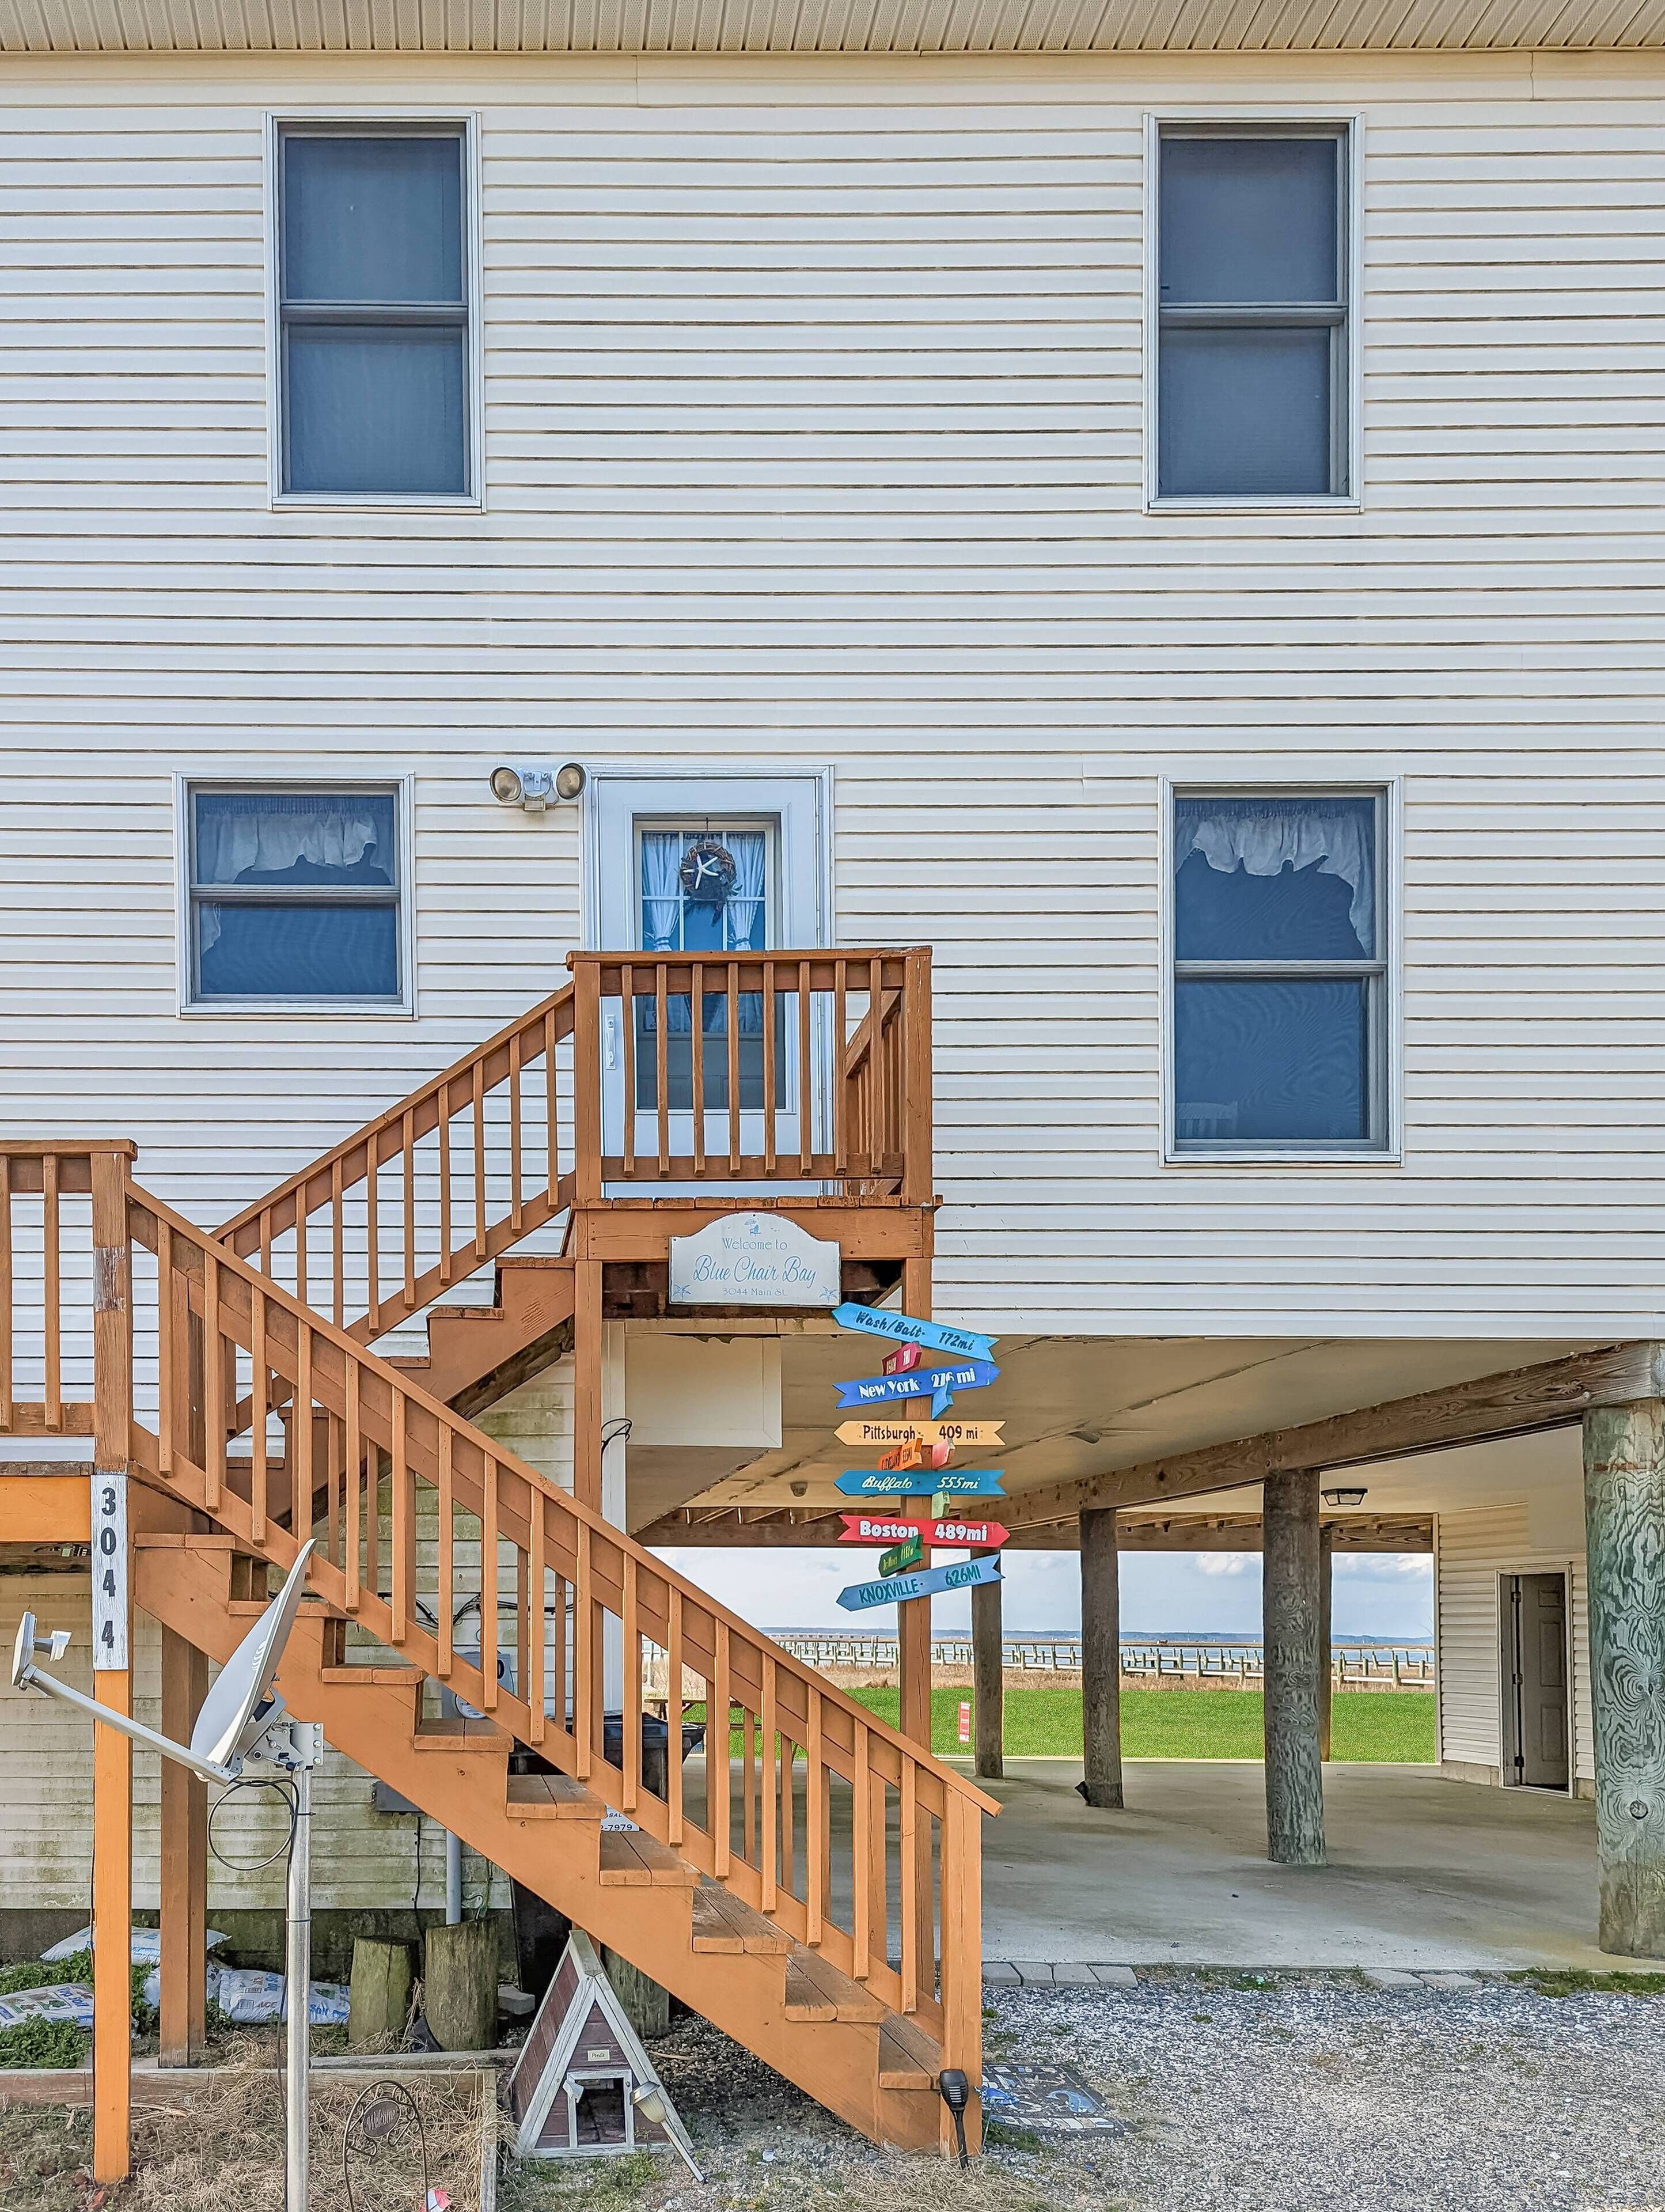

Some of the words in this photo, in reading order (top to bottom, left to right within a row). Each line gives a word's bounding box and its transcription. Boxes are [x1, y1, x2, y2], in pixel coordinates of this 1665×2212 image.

[722, 1237, 772, 1250] Welcome
[775, 1239, 787, 1251] to
[693, 1254, 731, 1282] Blue
[734, 1256, 779, 1282] Chair
[782, 1256, 817, 1289] Bay
[723, 1287, 748, 1296] 3044
[751, 1287, 771, 1296] Main
[859, 1384, 885, 1398] New
[889, 1378, 920, 1395] York
[957, 1368, 976, 1384] mi
[863, 1425, 916, 1444] Pittsburgh
[939, 1425, 962, 1440] 409
[966, 1426, 978, 1439] mi
[862, 1476, 913, 1491] Buffalo
[936, 1476, 981, 1489] 555mi
[860, 1520, 919, 1539] Boston
[935, 1524, 988, 1541] 489mi
[100, 1487, 116, 1649] 3044
[858, 1578, 920, 1604] KNOXVILLE
[945, 1565, 982, 1587] 626MI
[366, 2109, 396, 2132] Welcome
